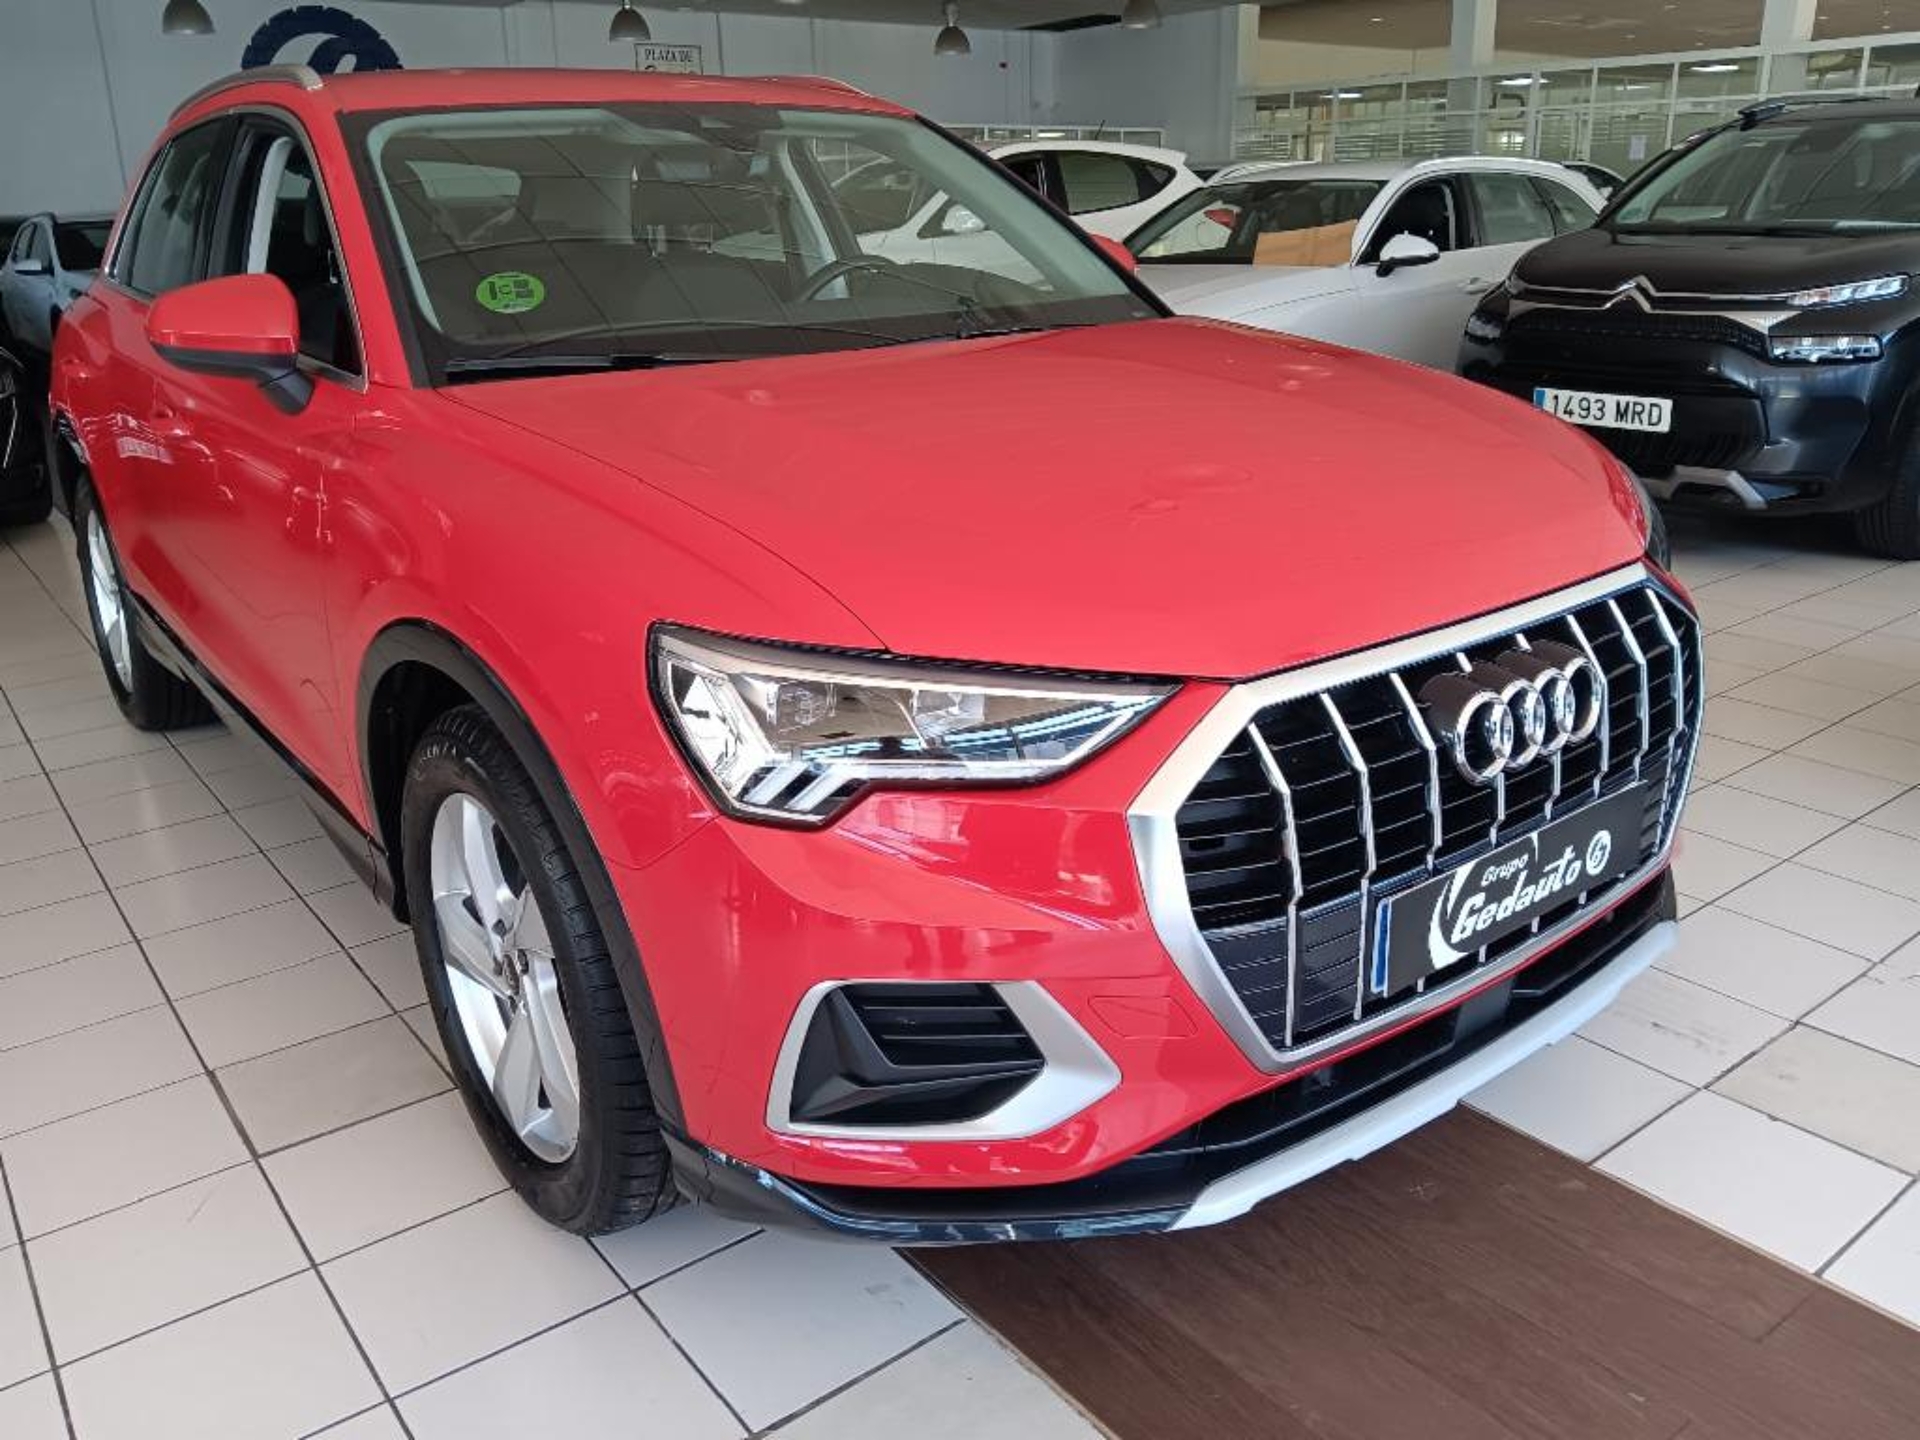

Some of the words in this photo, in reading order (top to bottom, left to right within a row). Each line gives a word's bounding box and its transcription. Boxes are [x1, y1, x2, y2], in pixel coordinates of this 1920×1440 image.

[645, 48, 679, 62] PLAZA
[1552, 395, 1606, 421] 1493
[1614, 399, 1662, 426] MRD
[1481, 853, 1529, 887] Grupo
[1451, 845, 1583, 944] Gedauto
